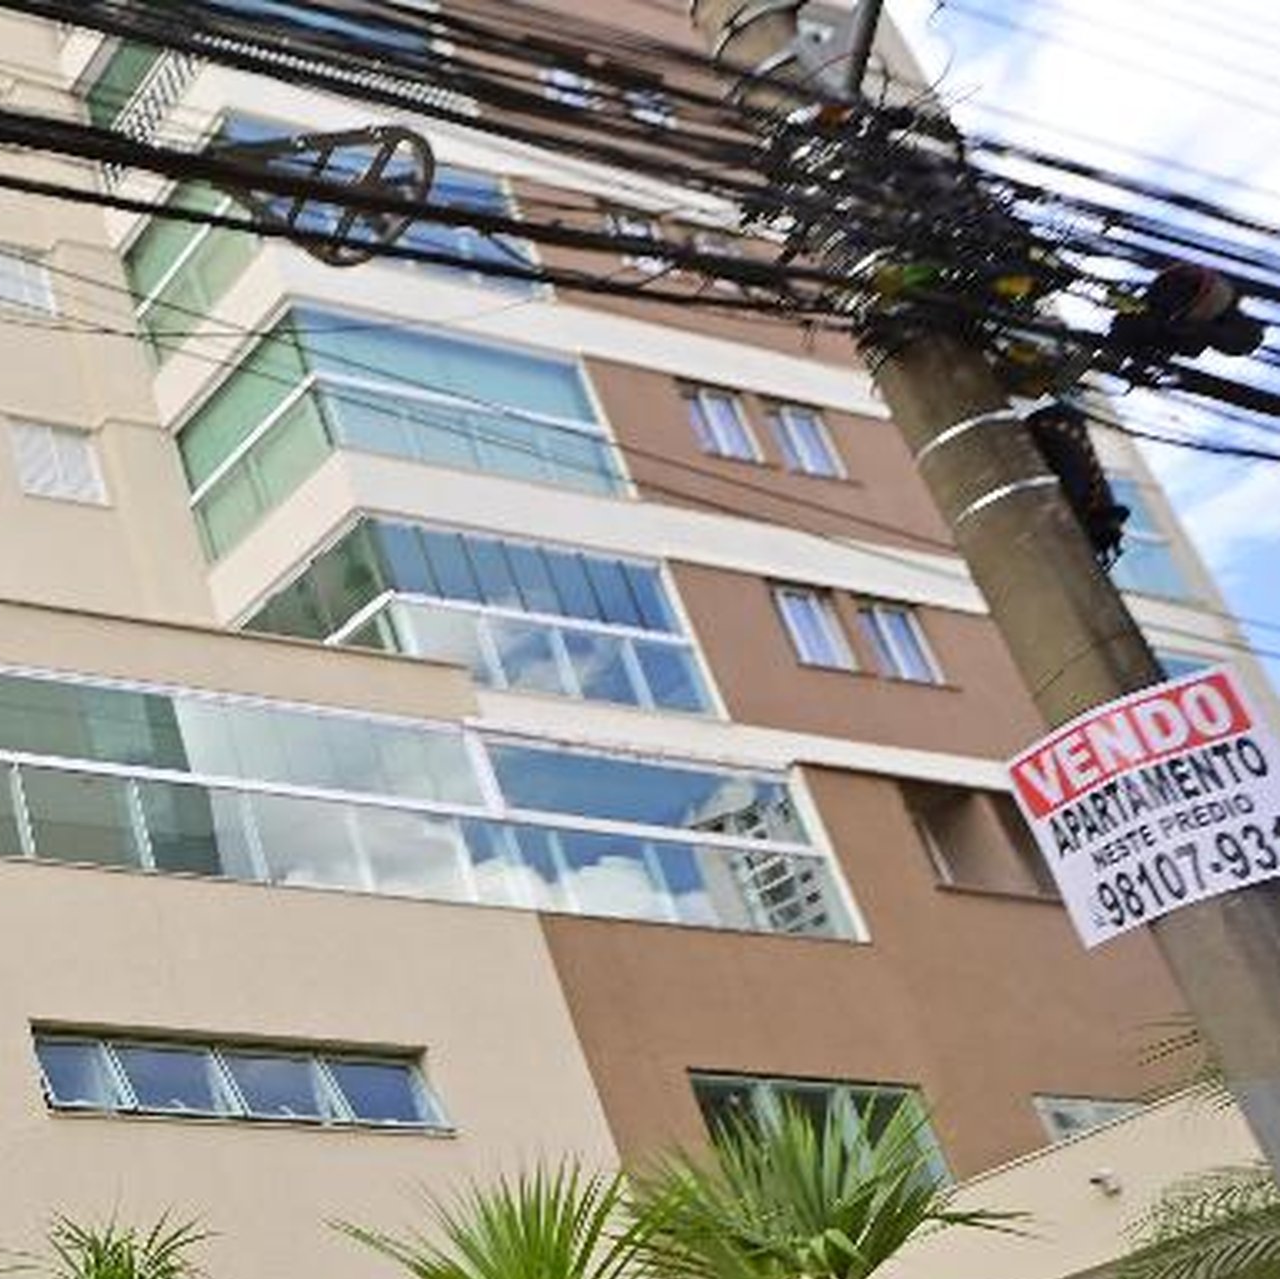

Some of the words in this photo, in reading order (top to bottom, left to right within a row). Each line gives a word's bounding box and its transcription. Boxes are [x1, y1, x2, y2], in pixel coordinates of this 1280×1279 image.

[1018, 682, 1234, 803] VENDO
[1049, 737, 1268, 856] APARTAMENTO
[1092, 824, 1156, 869] NESTE
